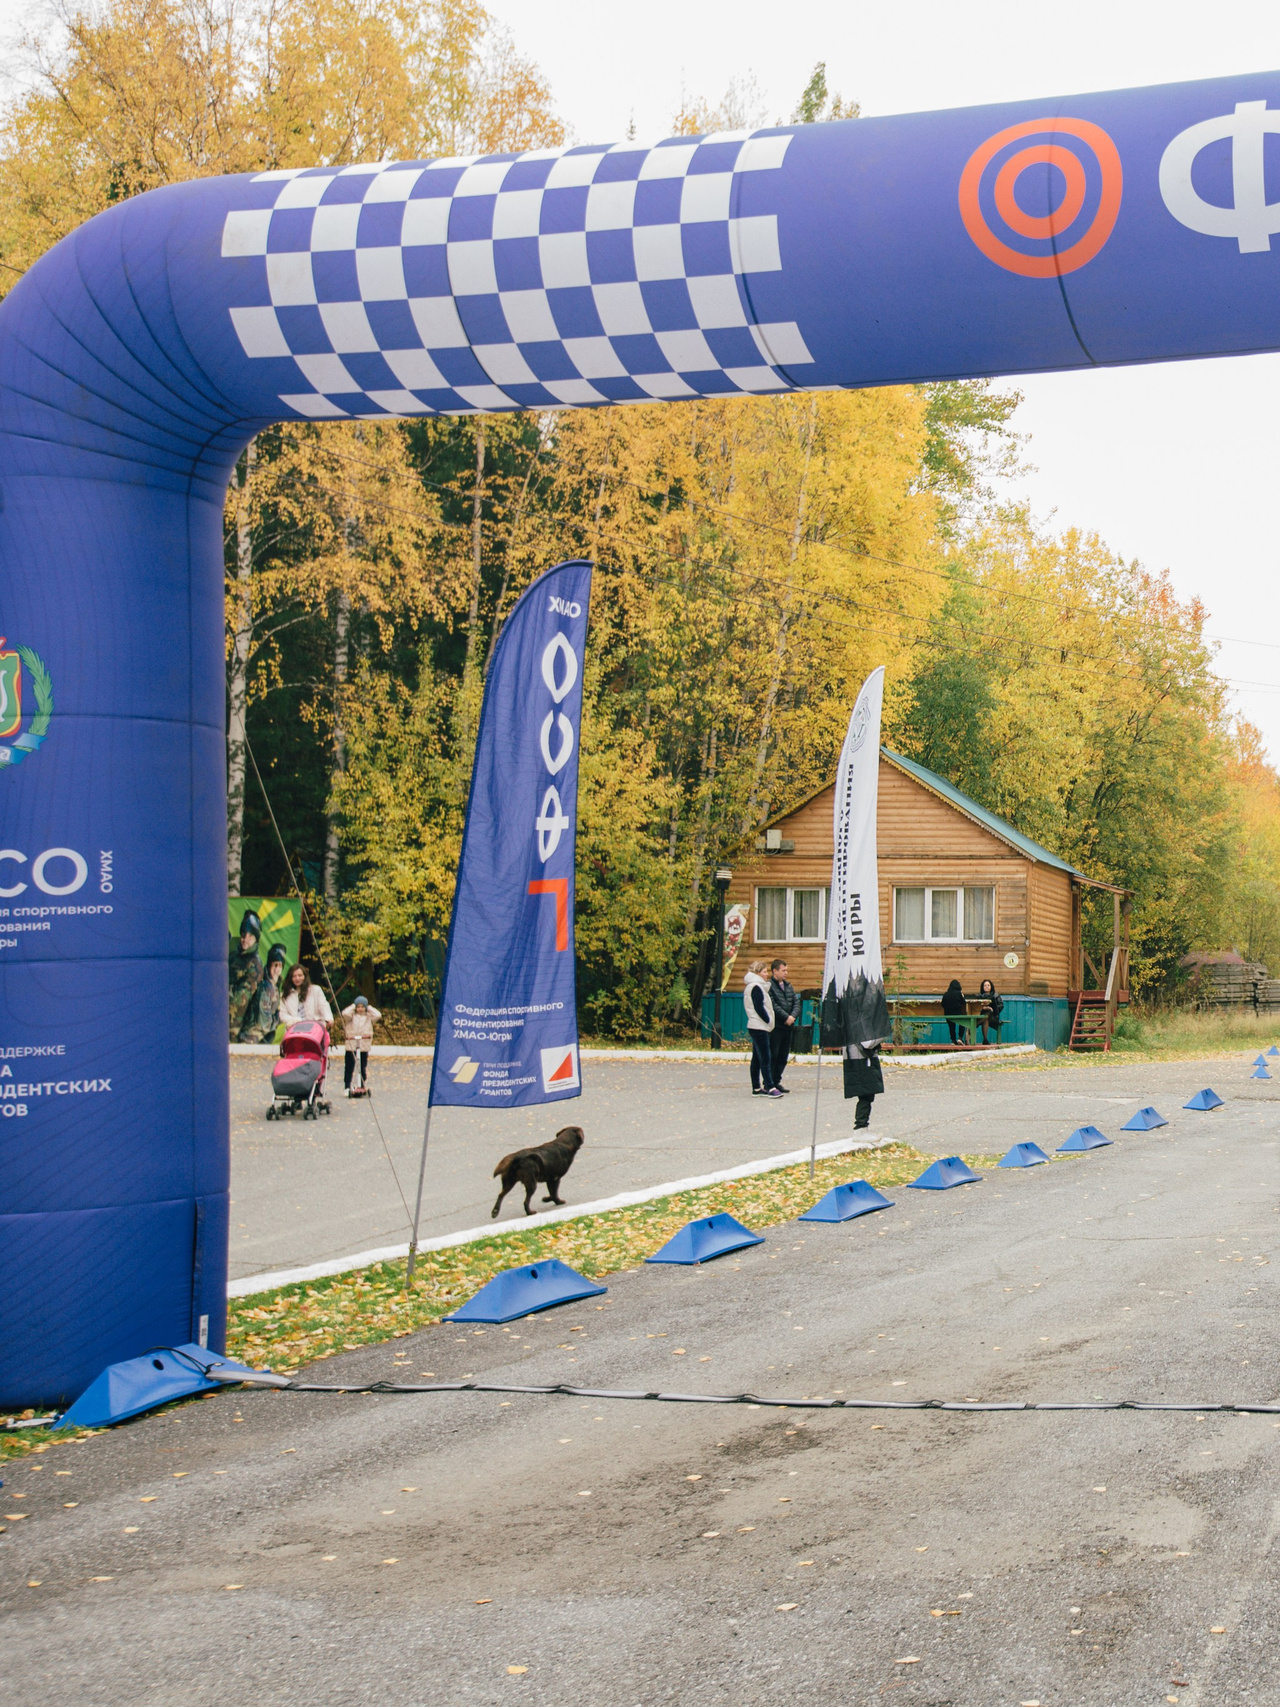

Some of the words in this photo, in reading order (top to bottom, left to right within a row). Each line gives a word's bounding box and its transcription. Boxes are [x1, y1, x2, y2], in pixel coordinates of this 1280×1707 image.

[100, 850, 113, 893] ХМАО
[13, 905, 114, 918] спортивного
[850, 893, 865, 957] ЮГРЫ
[455, 1004, 507, 1017] Федерация
[508, 1002, 564, 1015] спортивного
[453, 1018, 525, 1029] ориентирования
[453, 1029, 513, 1042] ХМАО-Югры
[483, 1070, 509, 1078] ФОНДА
[482, 1076, 537, 1087] ПРЕЗИДЕНТСКИХ
